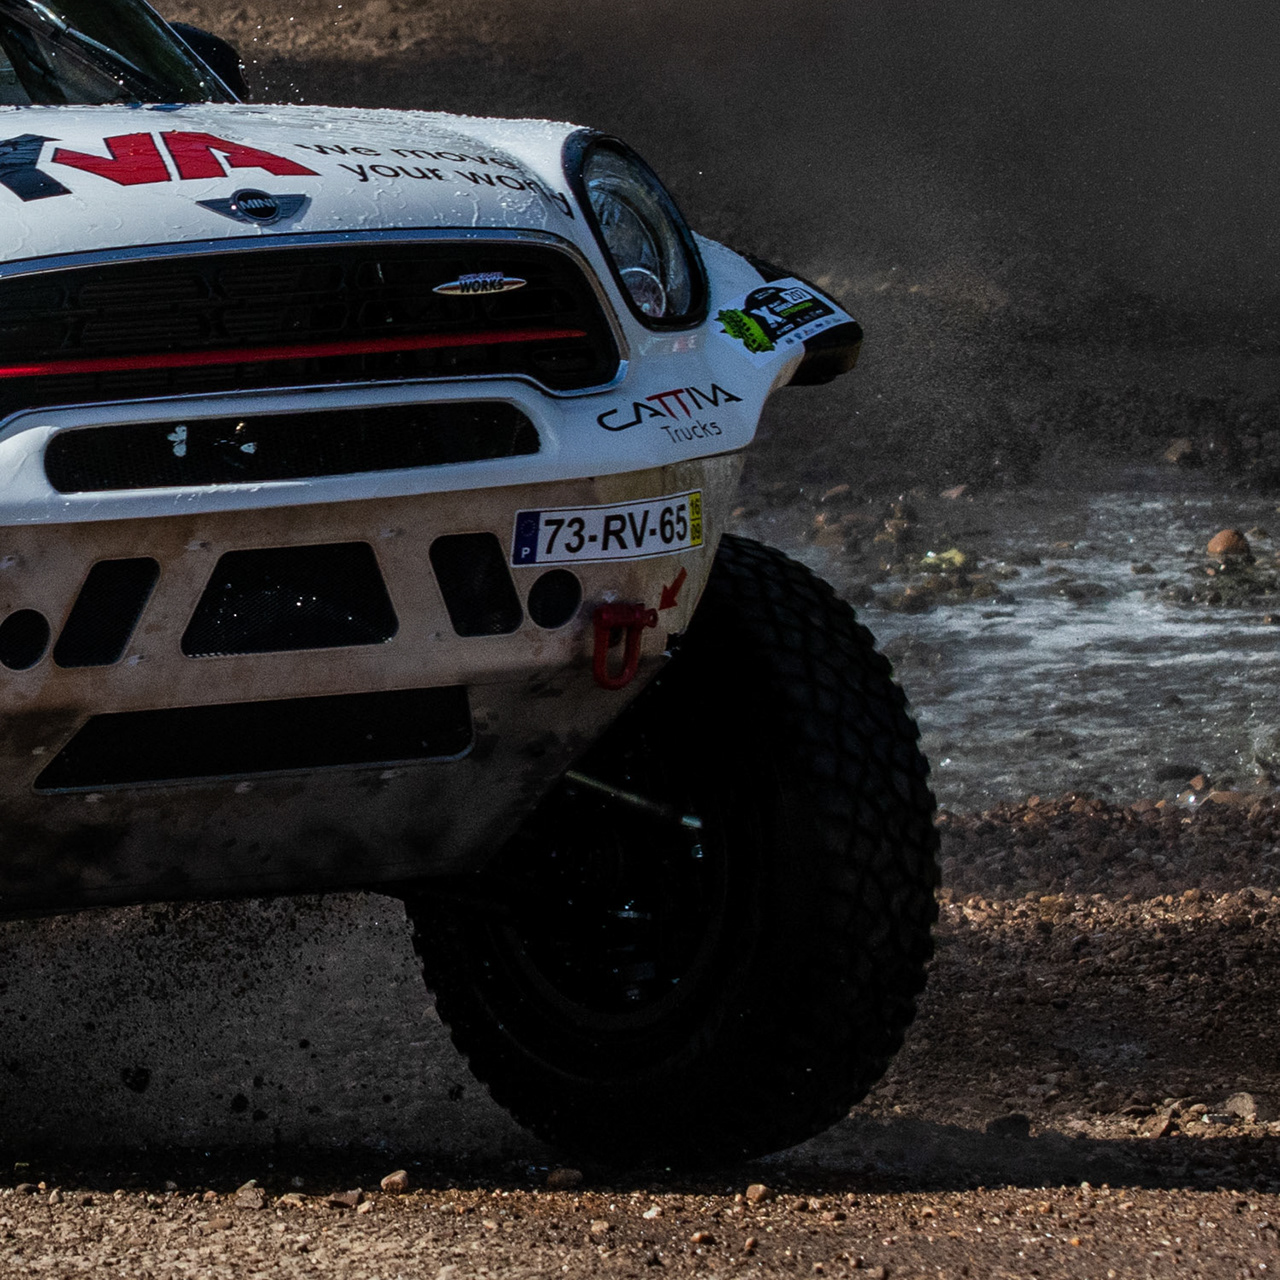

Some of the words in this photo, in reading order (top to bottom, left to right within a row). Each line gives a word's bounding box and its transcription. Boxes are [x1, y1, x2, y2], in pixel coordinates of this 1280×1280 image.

[337, 163, 445, 183] your
[239, 198, 276, 210] MINI
[459, 278, 505, 294] WORKS
[596, 383, 744, 432] CATTIVA
[660, 420, 723, 444] Trucks
[543, 503, 688, 555] 73-RV-65
[520, 546, 531, 559] P
